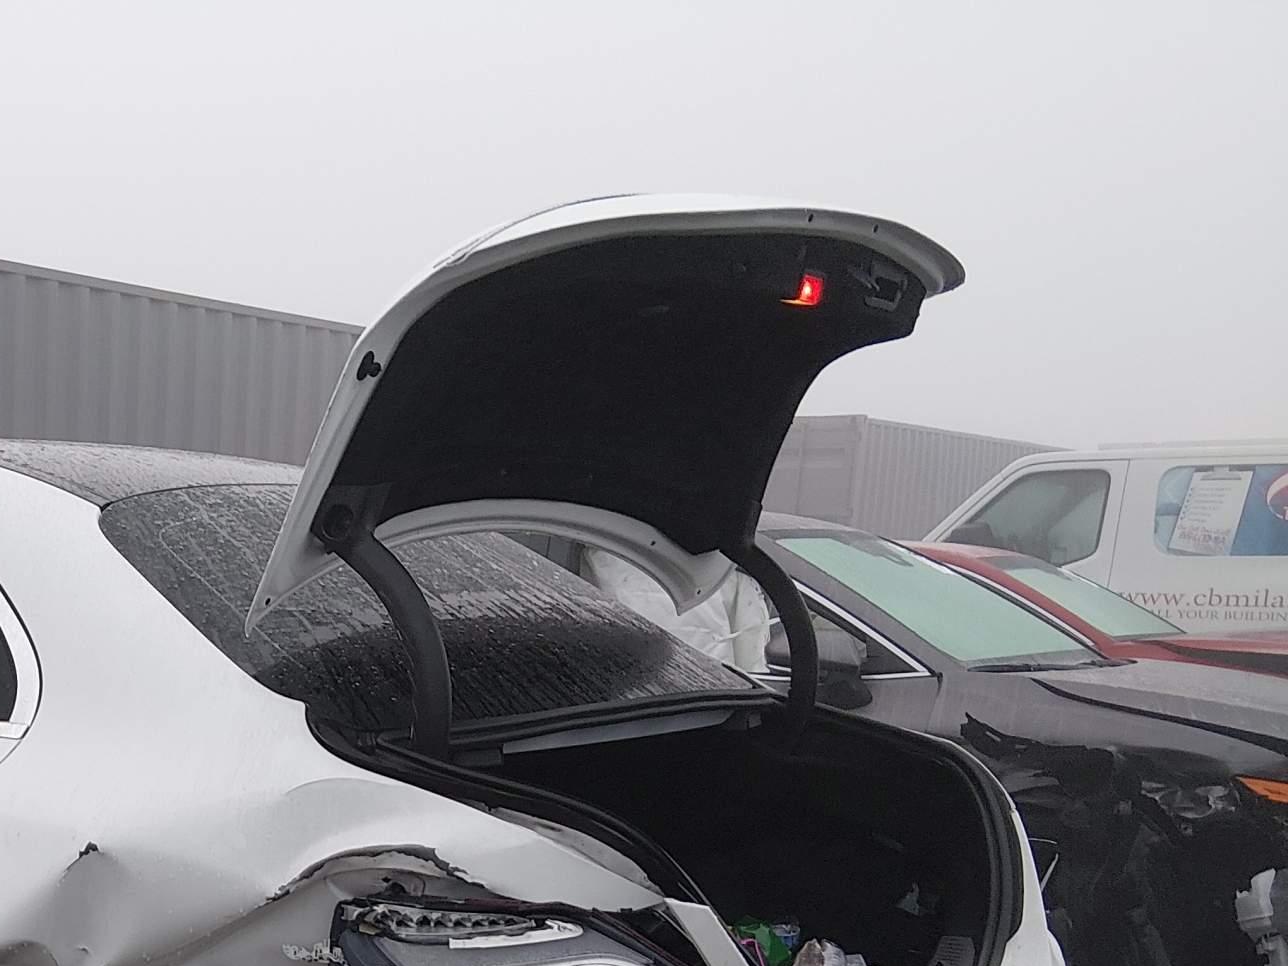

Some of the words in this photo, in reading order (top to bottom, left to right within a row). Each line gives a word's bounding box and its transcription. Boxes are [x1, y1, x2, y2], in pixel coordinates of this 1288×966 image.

[1119, 587, 1288, 609] www.cbmila
[1177, 608, 1219, 620] YOUR
[1224, 610, 1288, 623] BUILDIN
